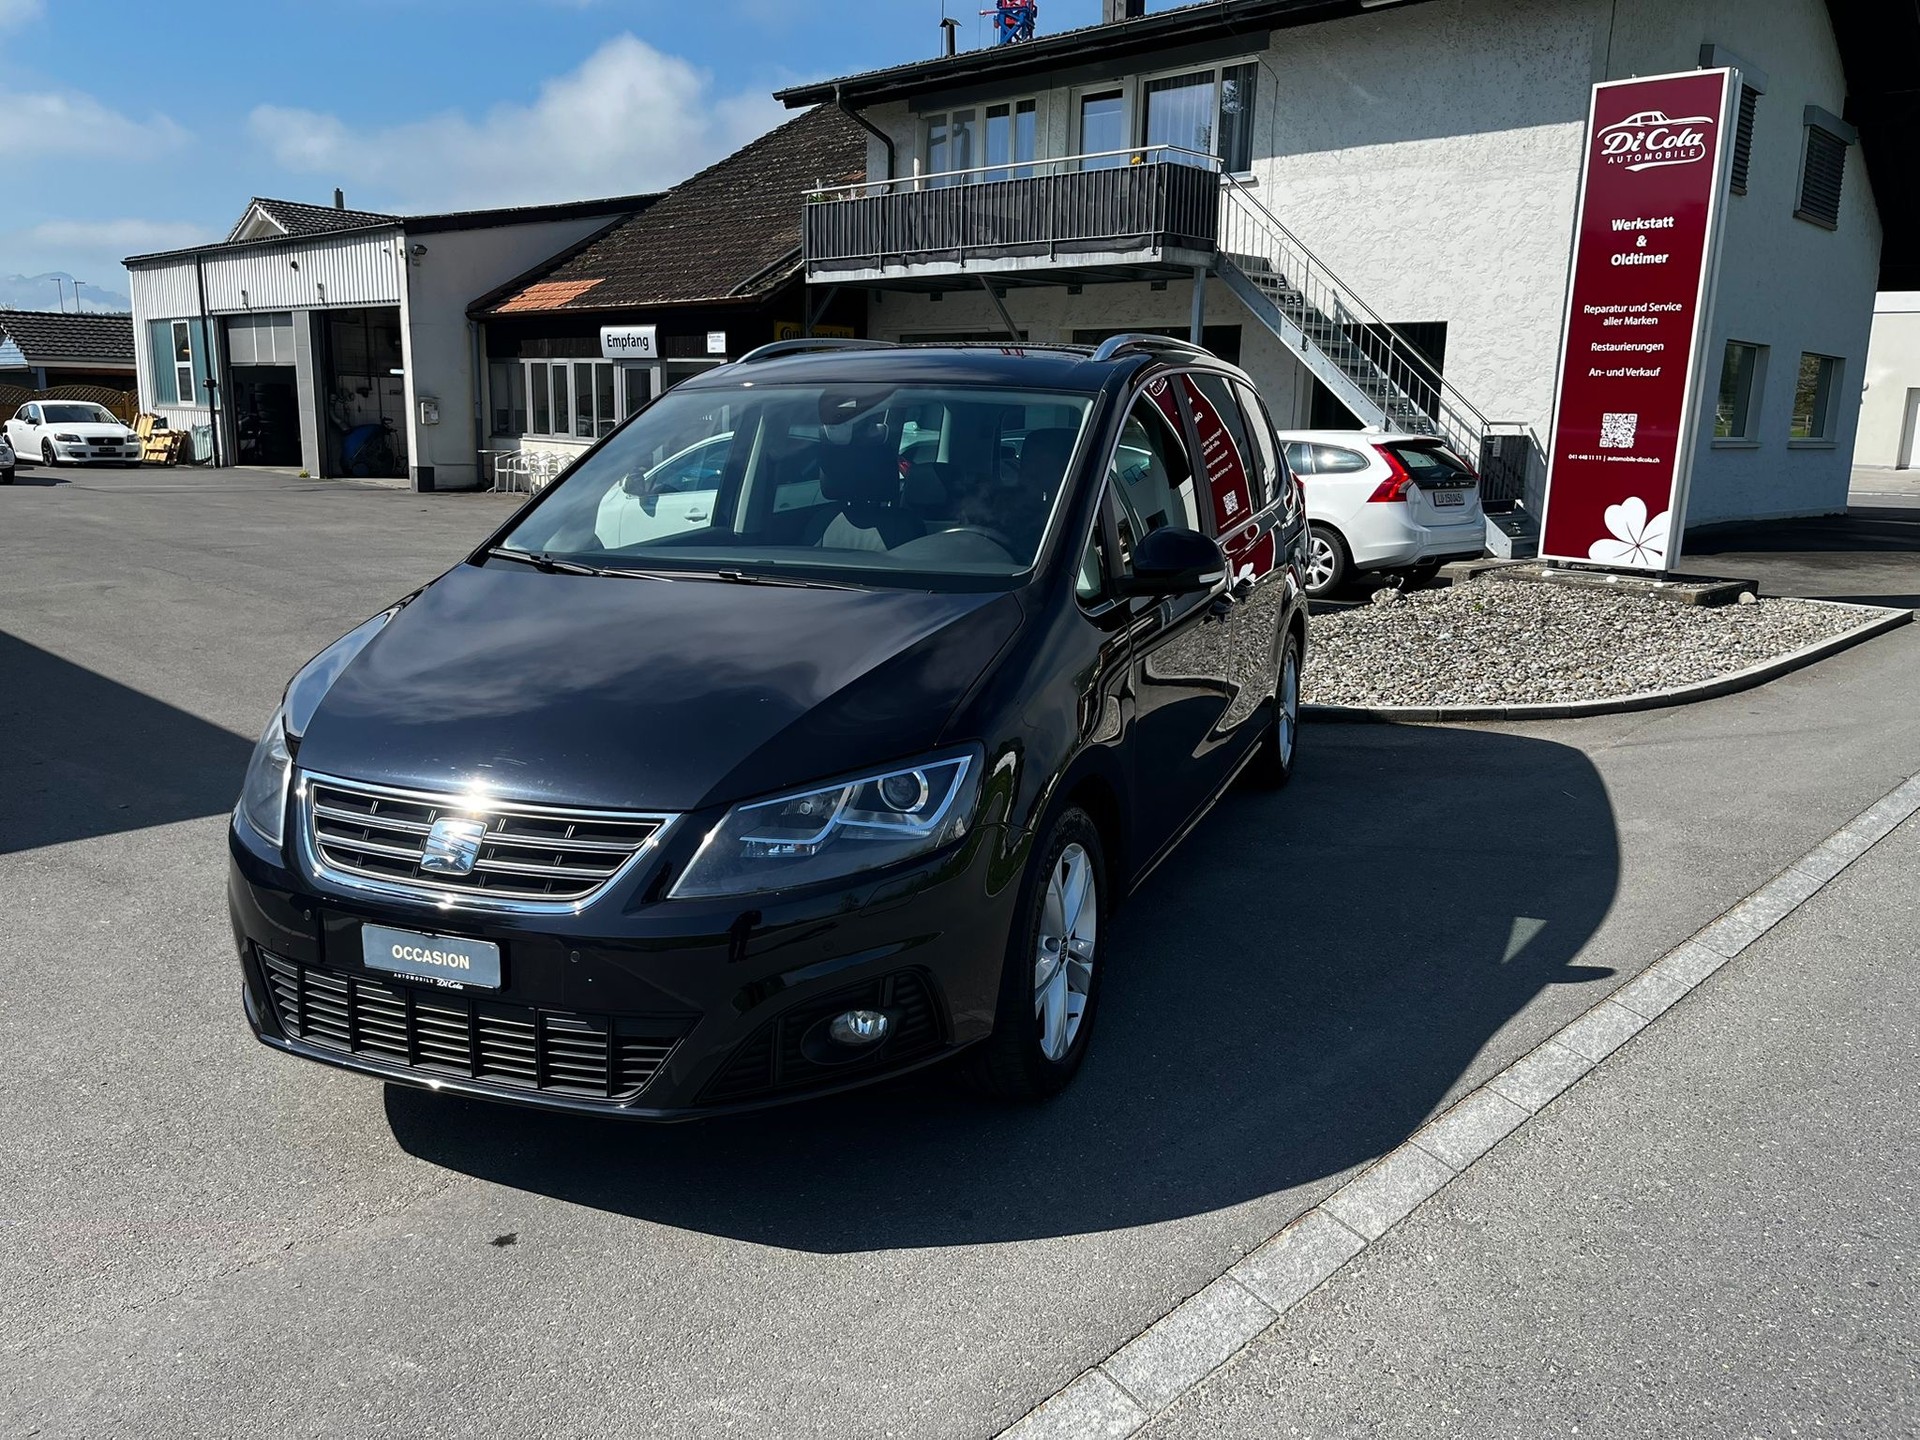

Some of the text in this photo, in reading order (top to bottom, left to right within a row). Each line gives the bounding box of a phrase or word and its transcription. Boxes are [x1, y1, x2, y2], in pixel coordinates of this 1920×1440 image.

[1601, 127, 1704, 155] Di Cola
[1607, 148, 1696, 164] AUTOMOBILE
[1611, 216, 1674, 231] Werkstatt
[1636, 234, 1648, 247] &
[1610, 252, 1669, 266] Oldtimer
[1583, 301, 1682, 315] Reparatur und Service
[1602, 315, 1658, 326] aller Marken
[606, 333, 649, 351] Empfang
[1590, 341, 1664, 353] Restaurierungen
[1588, 367, 1662, 377] An- und Verkauf
[391, 944, 470, 970] OCCASION
[393, 973, 433, 983] AUTOMOBILE
